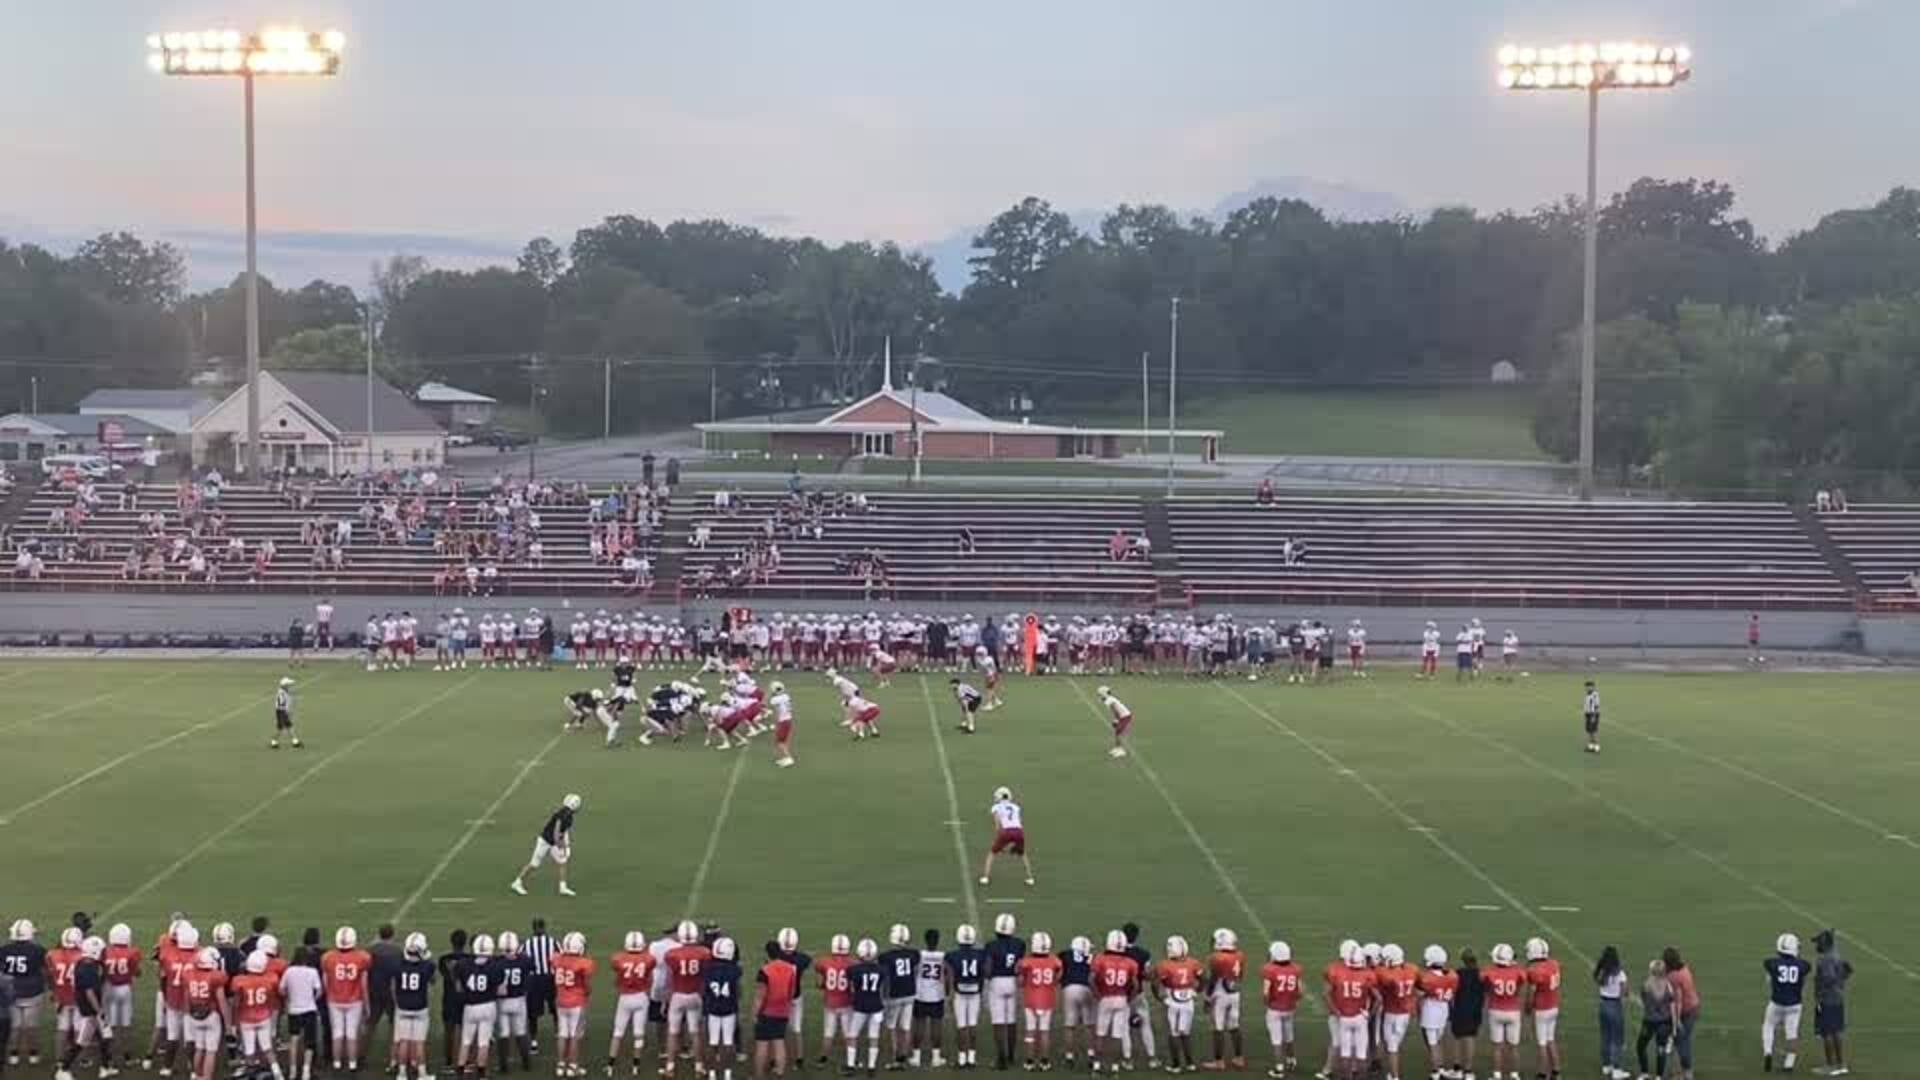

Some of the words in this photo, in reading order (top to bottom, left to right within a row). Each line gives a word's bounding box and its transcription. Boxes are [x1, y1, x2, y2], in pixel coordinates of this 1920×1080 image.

[1006, 806, 1014, 820] 7
[5, 956, 28, 973] 75
[335, 963, 358, 980] 63
[623, 962, 646, 978] 74
[679, 959, 700, 975] 18
[895, 958, 911, 976] 21
[922, 963, 942, 980] 23
[961, 959, 977, 977] 14
[401, 972, 420, 990] 18
[466, 973, 487, 991] 48
[555, 967, 575, 986] 62
[826, 967, 848, 991] 86
[862, 973, 879, 991] 17
[1031, 968, 1054, 985] 39
[1105, 969, 1127, 987] 38
[1177, 969, 1188, 984] 7
[1777, 965, 1799, 983] 30
[710, 980, 730, 997] 34
[1343, 981, 1362, 998] 15
[1398, 980, 1414, 997] 17
[1494, 979, 1516, 995] 30
[247, 987, 267, 1006] 16
